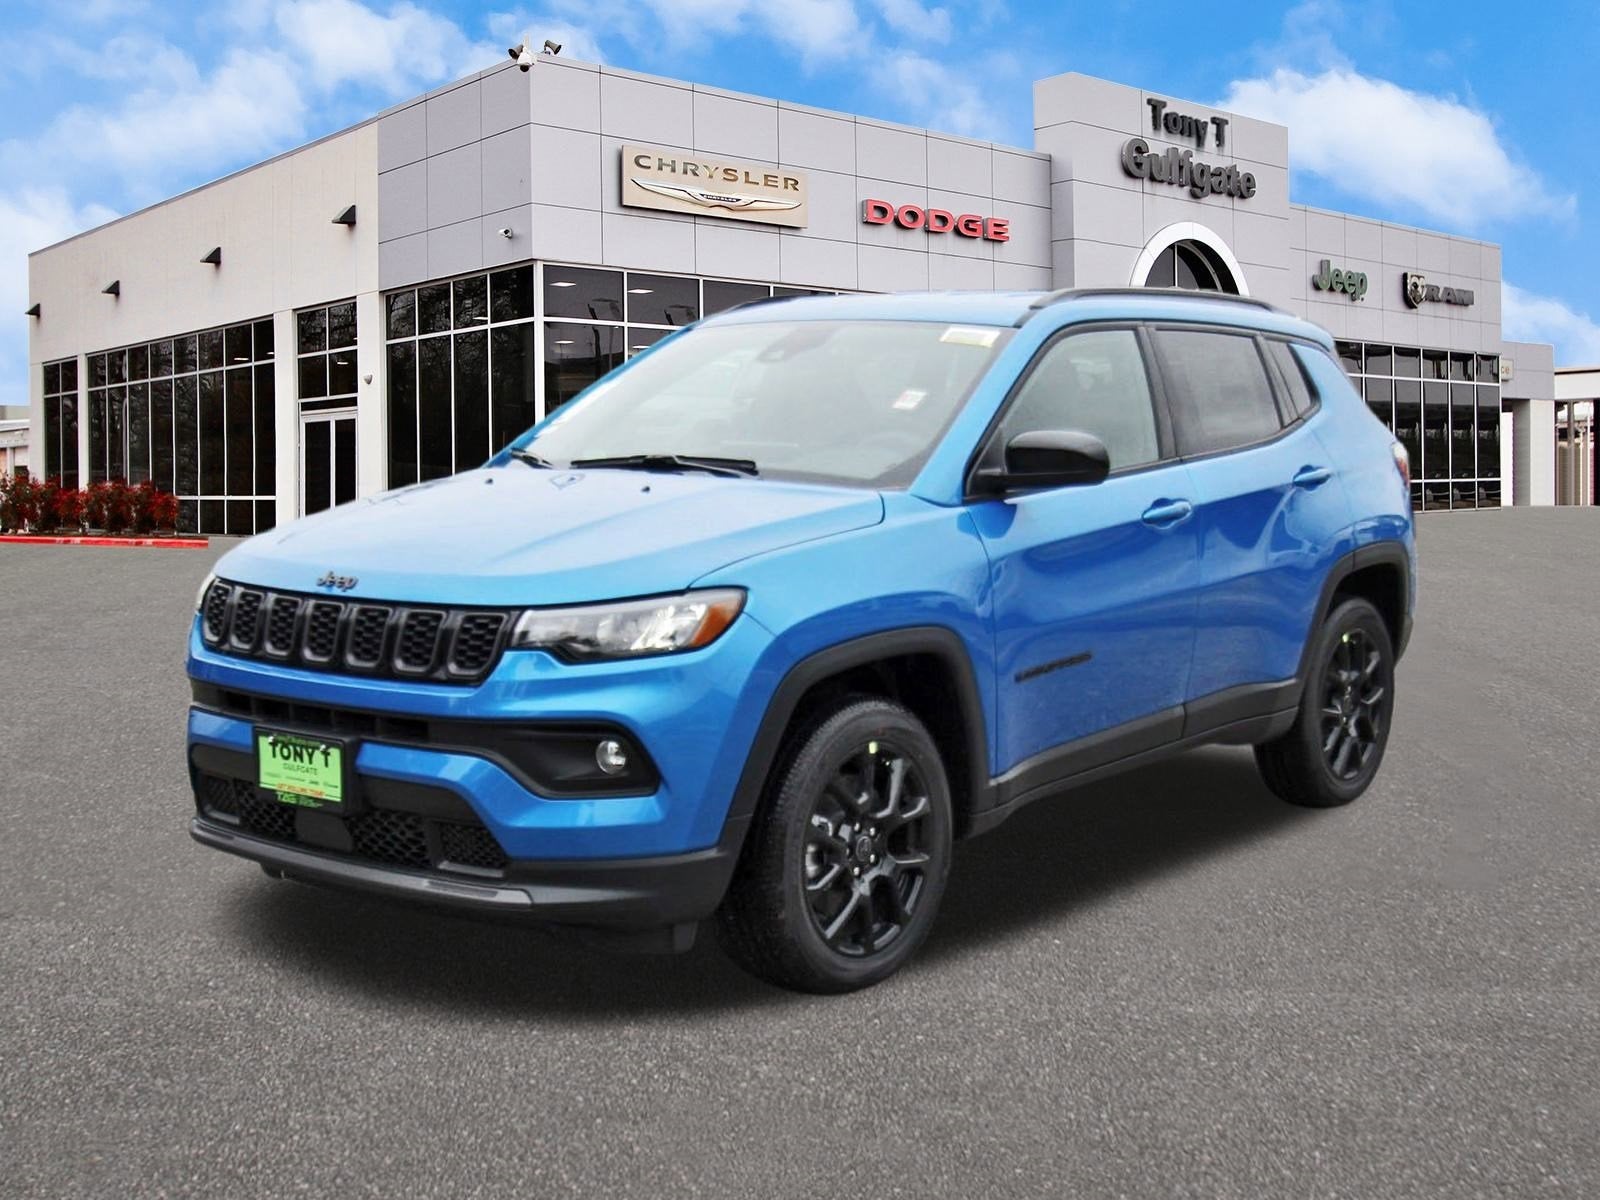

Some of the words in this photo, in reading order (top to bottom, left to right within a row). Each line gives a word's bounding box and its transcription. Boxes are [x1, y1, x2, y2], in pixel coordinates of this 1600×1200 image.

[1146, 98, 1208, 147] Tony
[1210, 116, 1229, 147] T
[634, 154, 800, 191] CHRYSLER
[1121, 138, 1257, 199] Gulfgate
[862, 199, 1010, 242] DODGE
[1312, 259, 1368, 301] Jeep
[1425, 284, 1475, 306] RAM
[316, 570, 359, 592] Jeep
[268, 738, 315, 765] TONY
